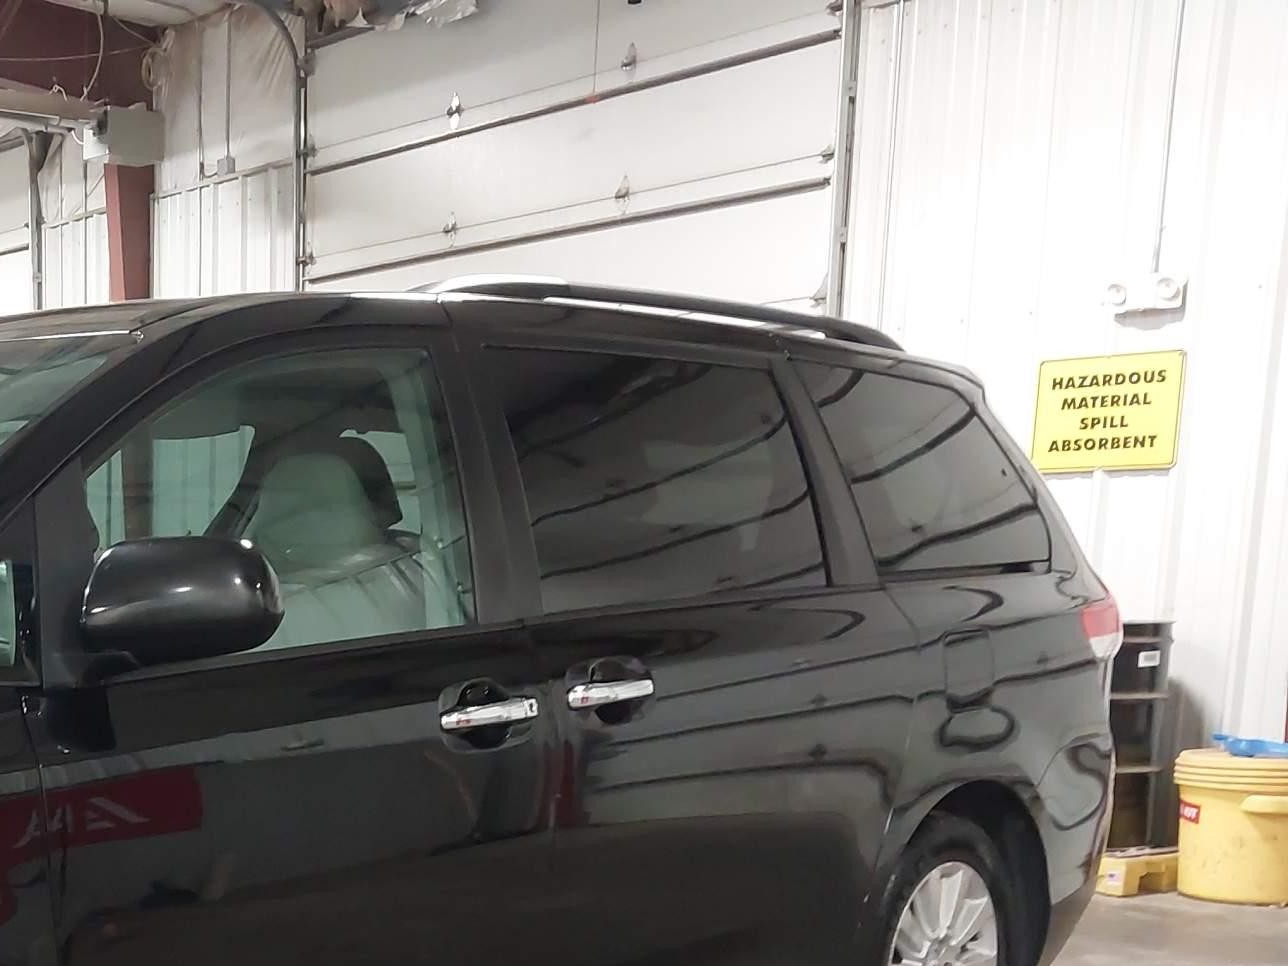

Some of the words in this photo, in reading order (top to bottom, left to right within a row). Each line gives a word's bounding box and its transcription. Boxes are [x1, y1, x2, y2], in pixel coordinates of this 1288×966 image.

[1051, 369, 1167, 391] HAZARDOUS
[1061, 392, 1152, 411] MATERIAL
[1079, 415, 1129, 430] SPILL
[1048, 435, 1158, 453] ABSORBENT
